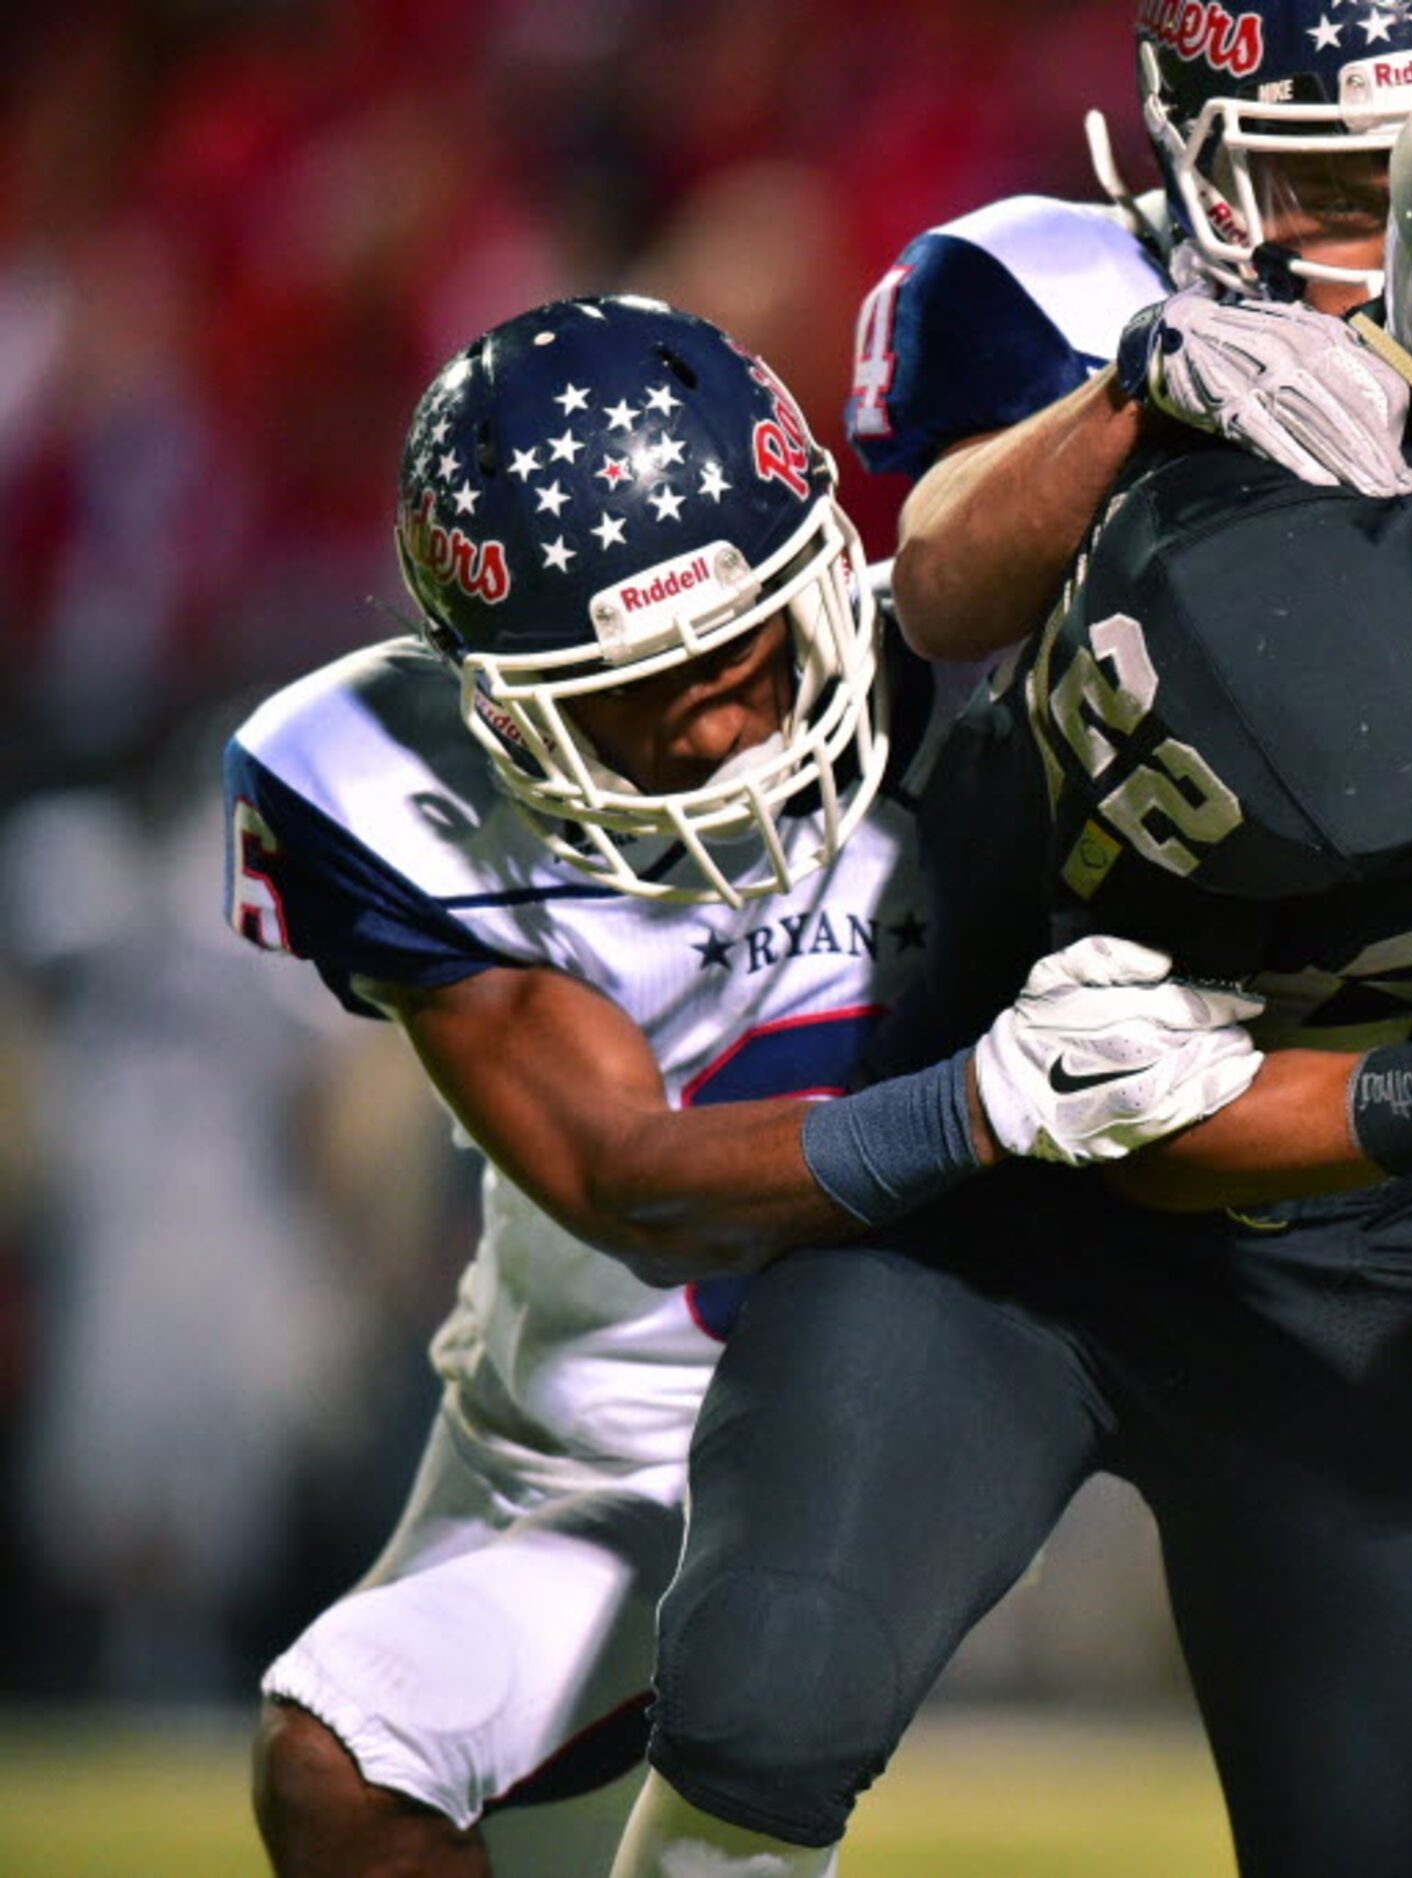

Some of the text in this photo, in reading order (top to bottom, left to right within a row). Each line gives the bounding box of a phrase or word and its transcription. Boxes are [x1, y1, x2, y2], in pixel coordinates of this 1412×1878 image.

[853, 264, 914, 441] 4
[396, 486, 511, 605] ders
[620, 557, 710, 613] Riddell
[746, 911, 881, 974] RYAN
